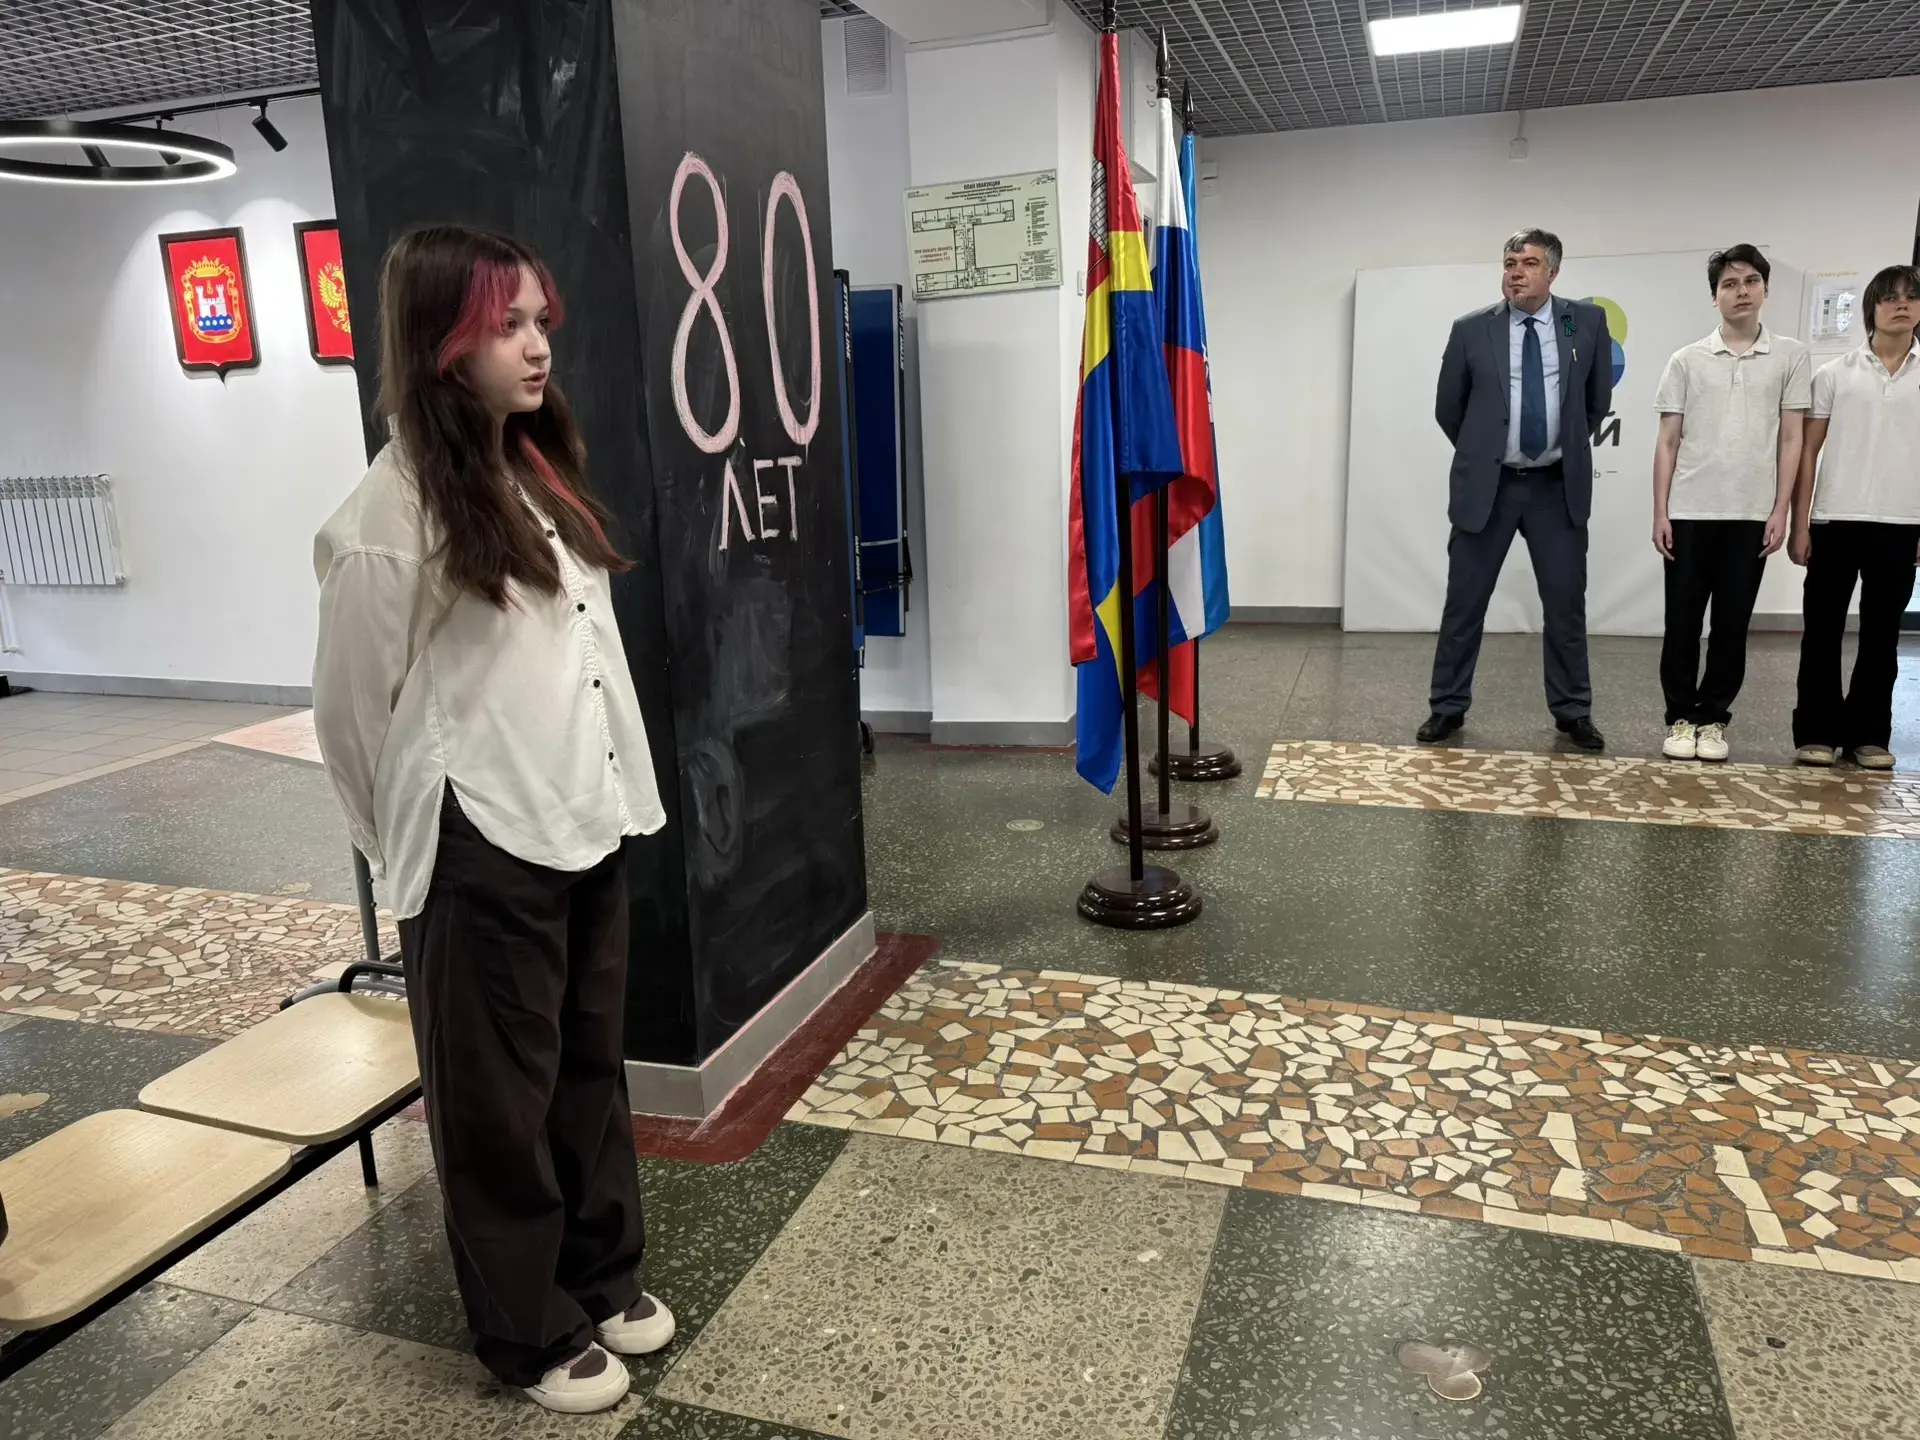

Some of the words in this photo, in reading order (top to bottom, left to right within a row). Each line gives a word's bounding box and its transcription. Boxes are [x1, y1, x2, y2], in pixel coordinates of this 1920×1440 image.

[976, 180, 1001, 189] ЭВАКУАЦИИ
[669, 151, 822, 454] 80
[718, 455, 803, 551] ЛЕТ
